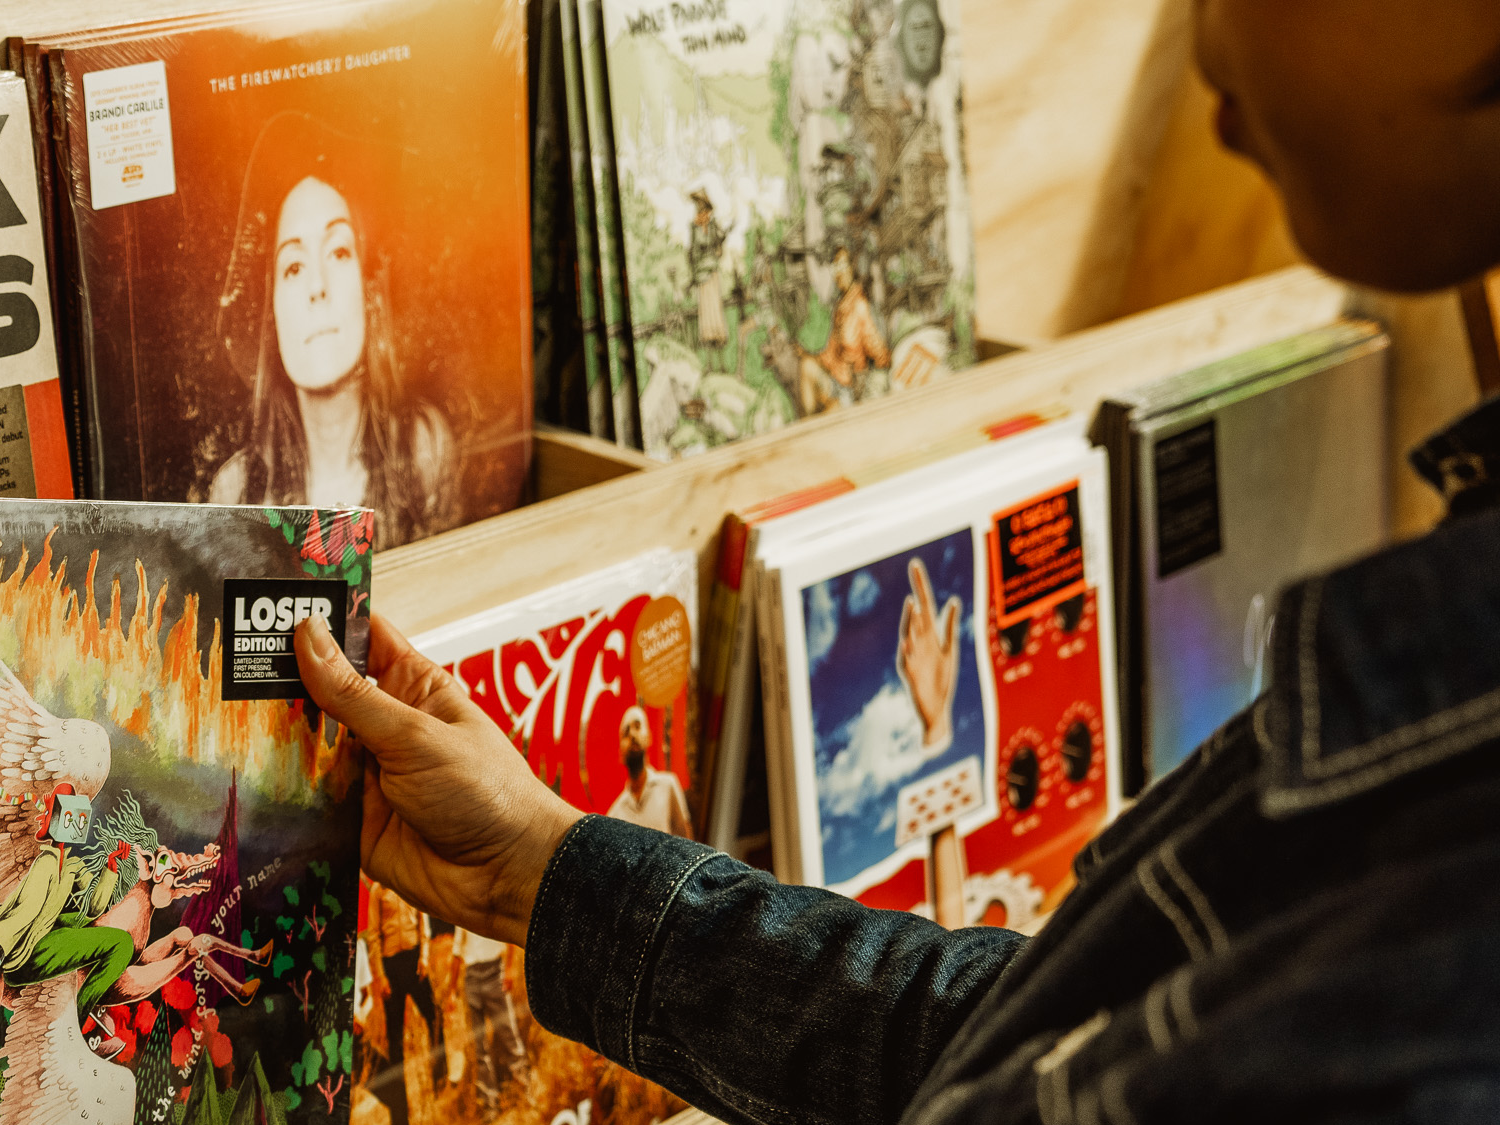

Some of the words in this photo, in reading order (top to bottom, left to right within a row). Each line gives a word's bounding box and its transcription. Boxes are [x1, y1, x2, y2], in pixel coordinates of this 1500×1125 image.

[209, 75, 236, 94] THE
[345, 44, 411, 71] DAUGHTER
[89, 106, 125, 122] BRANDI
[127, 98, 164, 115] CARLILE
[1, 430, 23, 444] debut
[234, 596, 333, 632] LOSER
[233, 636, 286, 652] EDITION
[233, 657, 272, 665] LIMITED-EDITION
[233, 664, 248, 672] FIRST
[152, 1085, 176, 1123] the
[178, 1029, 204, 1081] wind
[195, 934, 216, 1019] forgets
[211, 885, 242, 936] your
[247, 855, 283, 891] name
